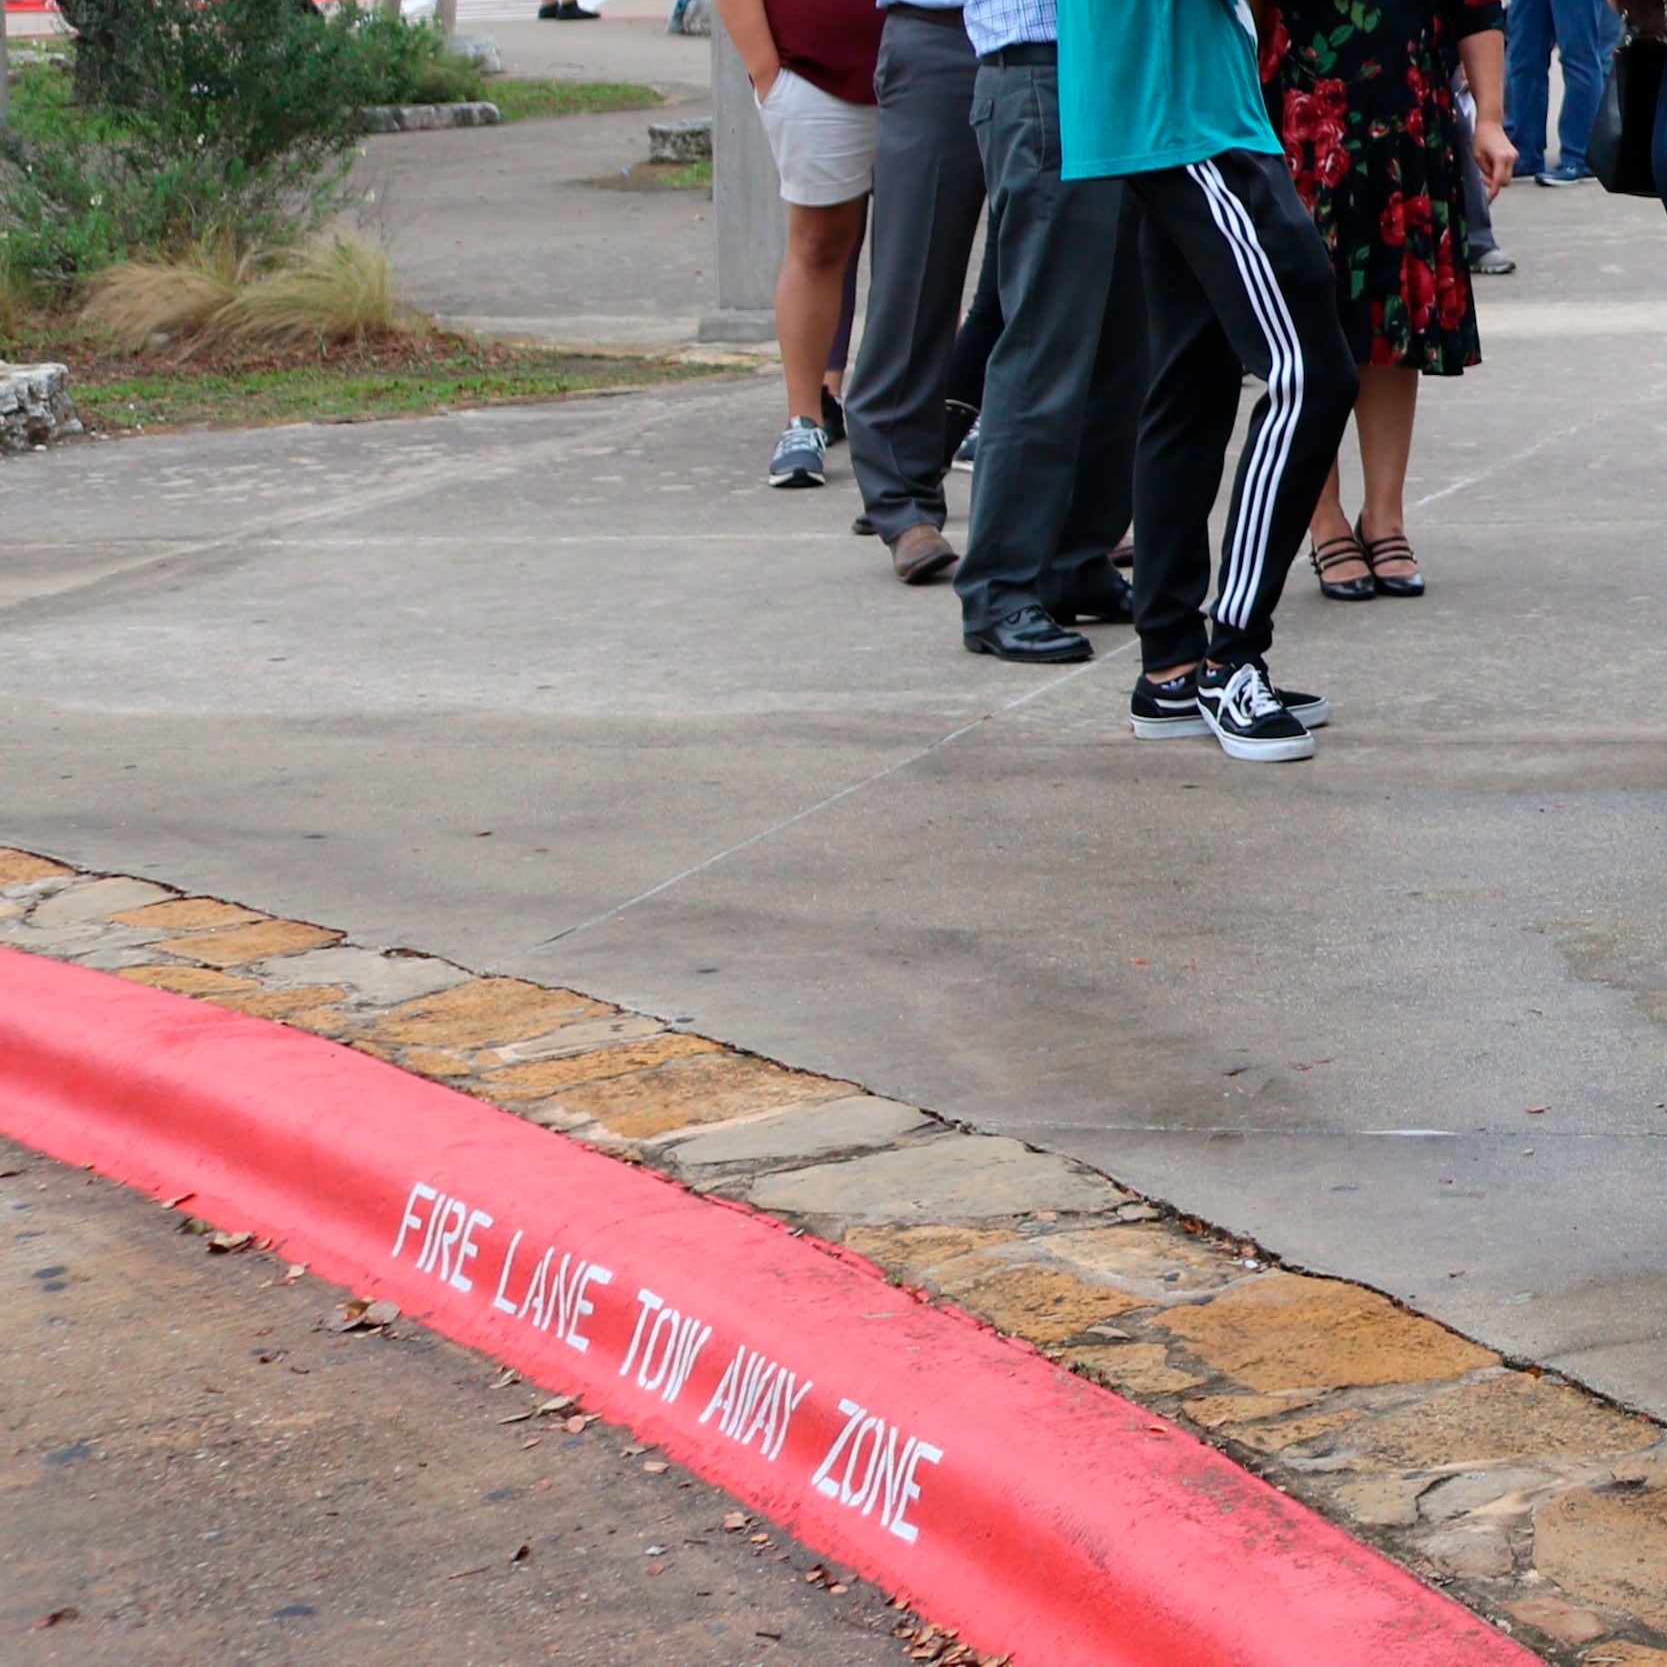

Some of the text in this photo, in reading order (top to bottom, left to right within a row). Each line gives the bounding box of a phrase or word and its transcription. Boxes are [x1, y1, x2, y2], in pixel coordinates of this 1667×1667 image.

[391, 1181, 944, 1543] FIRE LANE TOW AWAY ZONE
